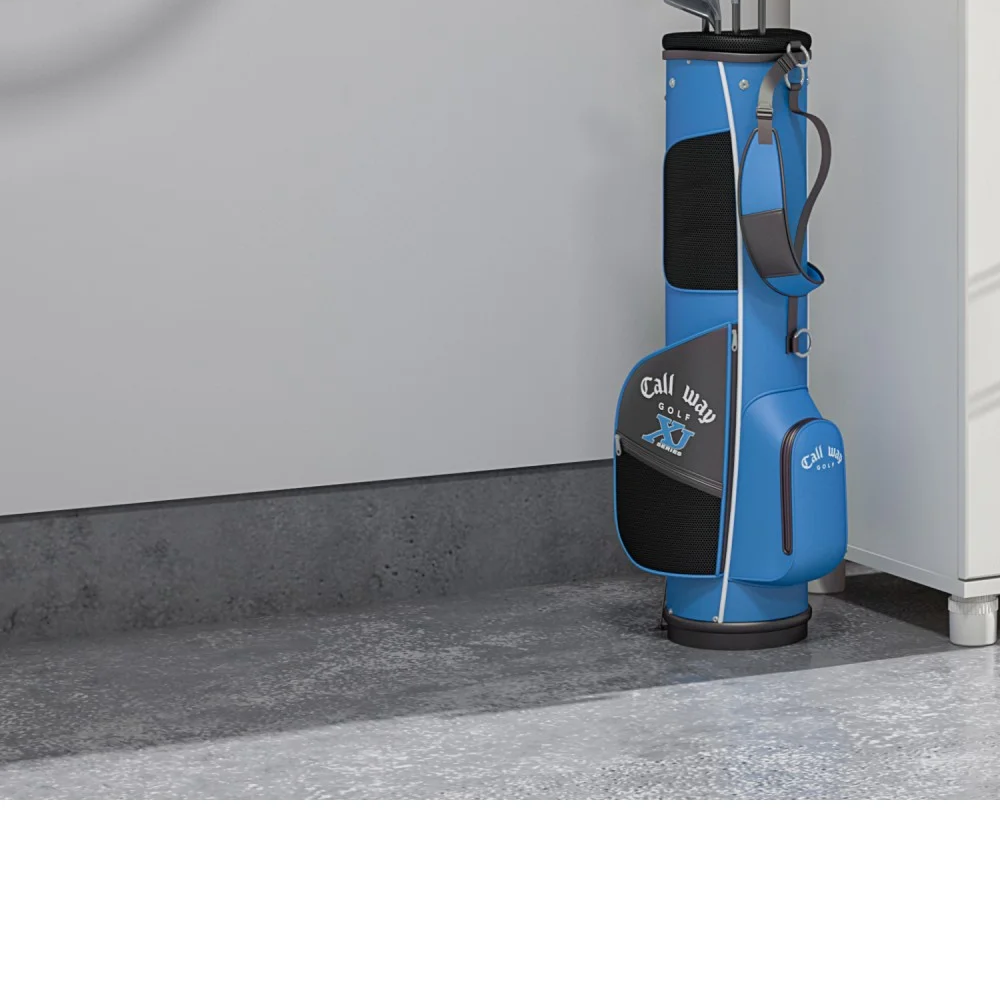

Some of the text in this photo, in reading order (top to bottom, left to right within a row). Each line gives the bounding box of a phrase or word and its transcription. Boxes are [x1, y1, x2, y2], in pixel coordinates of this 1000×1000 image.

[641, 372, 717, 424] Call way
[658, 402, 691, 421] GOLF
[801, 445, 823, 469] Call
